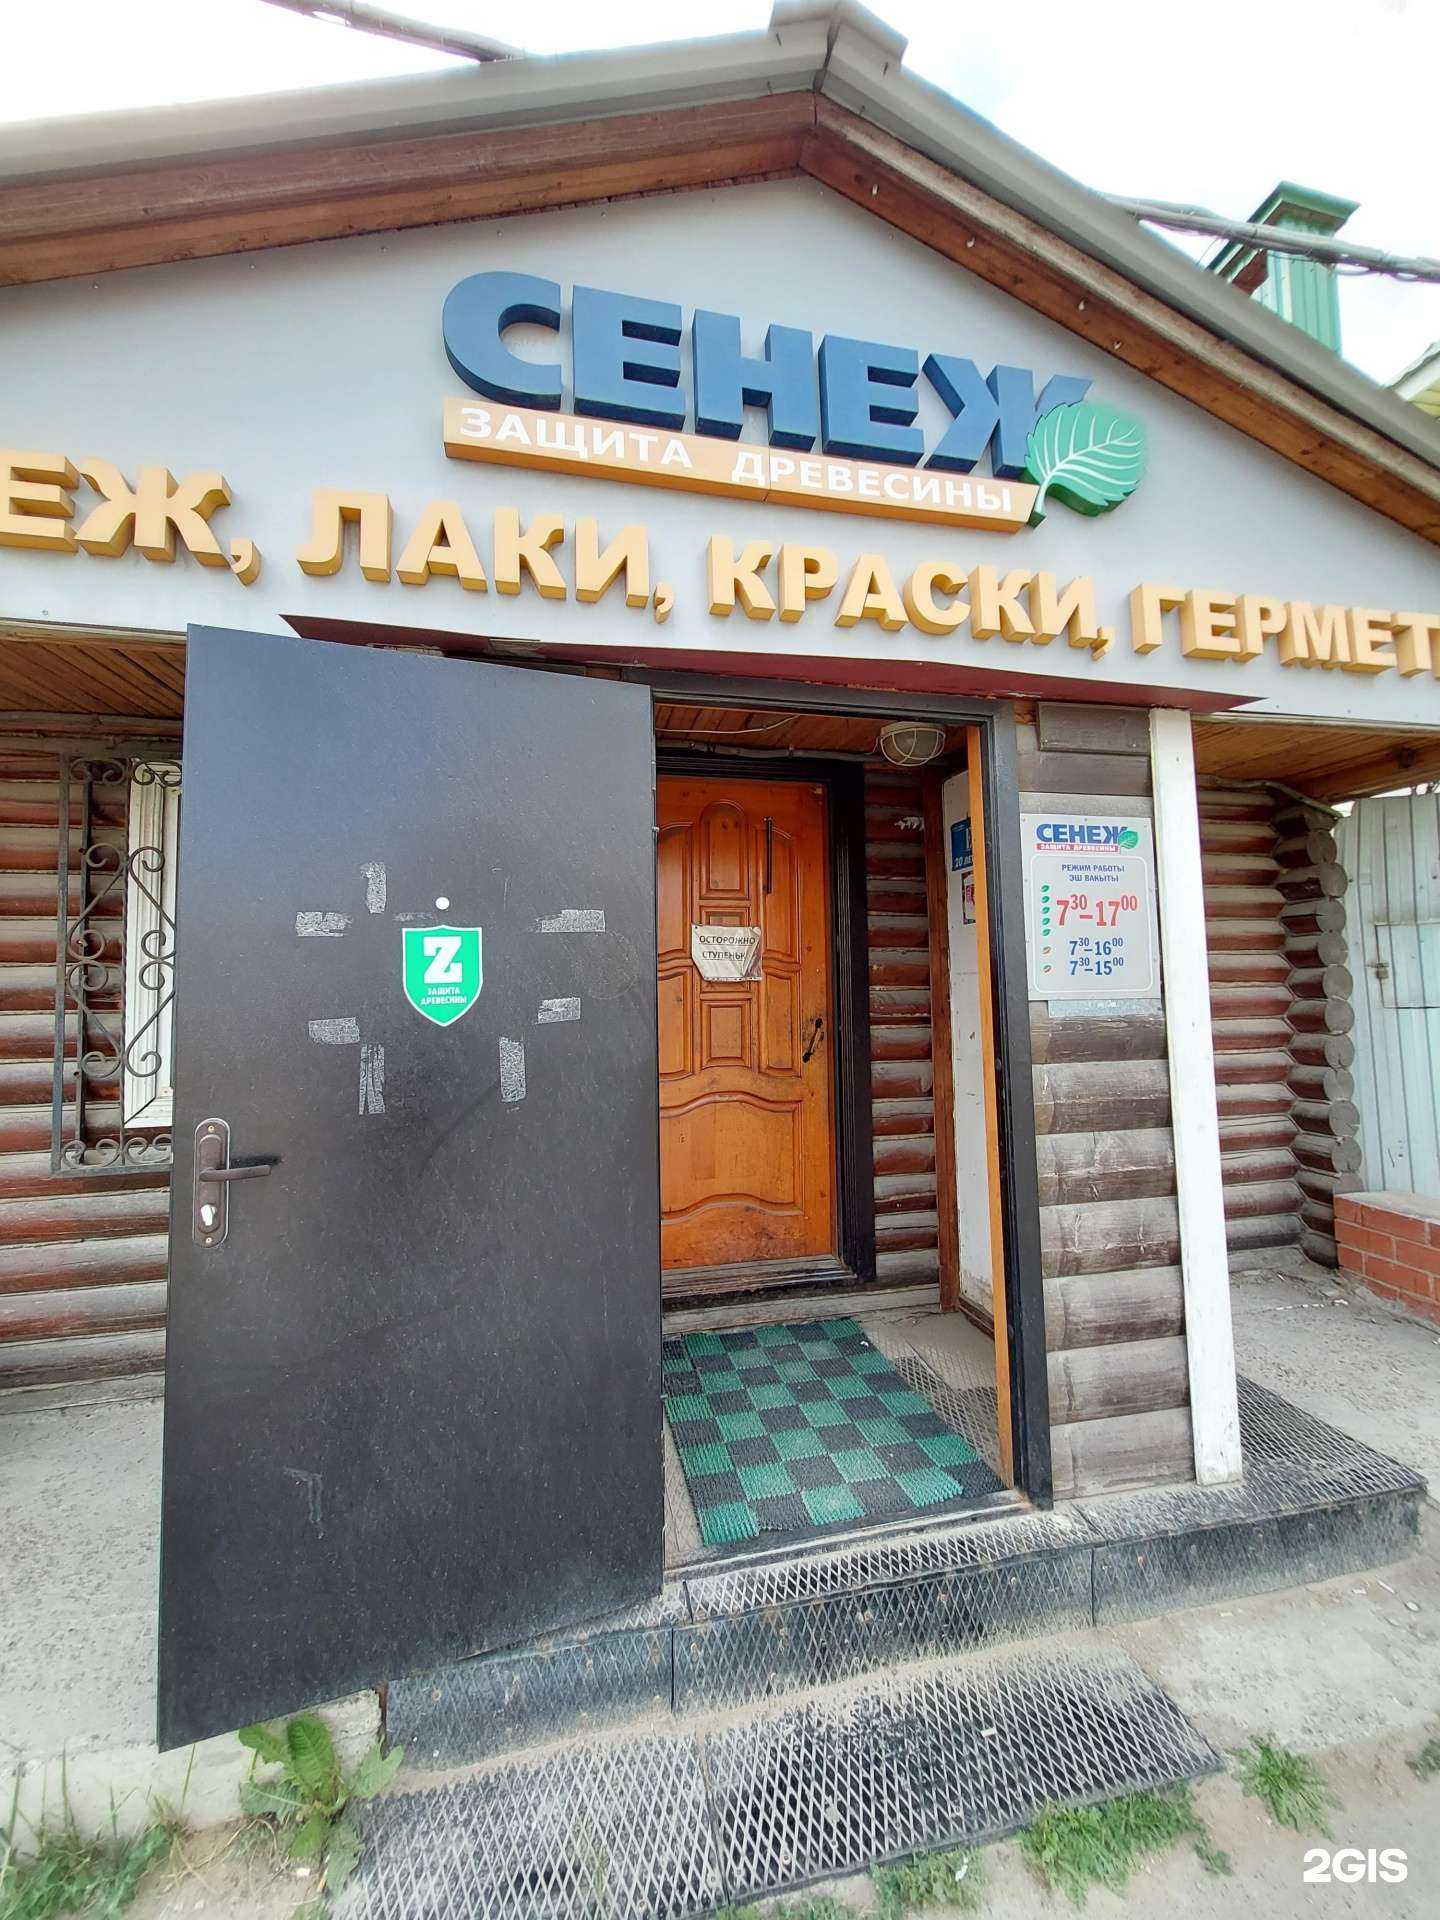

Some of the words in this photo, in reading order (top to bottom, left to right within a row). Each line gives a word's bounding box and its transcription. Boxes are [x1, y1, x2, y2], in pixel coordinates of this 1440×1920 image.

[442, 271, 1093, 478] СЕНЕЖ
[459, 406, 693, 469] ЗАЩИТА
[731, 451, 1013, 513] ДРЕВЕСИНЫ
[0, 450, 262, 587] ЕЖ,
[296, 488, 674, 623] ЛАКИ,
[707, 535, 1115, 662] КРАСКИ,
[1036, 823, 1128, 844] СЕНЕЖ
[1061, 864, 1091, 872] РЕЖИМ
[1093, 864, 1125, 873] РАБОТЫ
[1069, 874, 1083, 882] ЭШ
[1084, 874, 1119, 883] ВАКЫТЫ
[699, 935, 756, 945] ОСТОРОЖНО
[423, 935, 463, 984] Z
